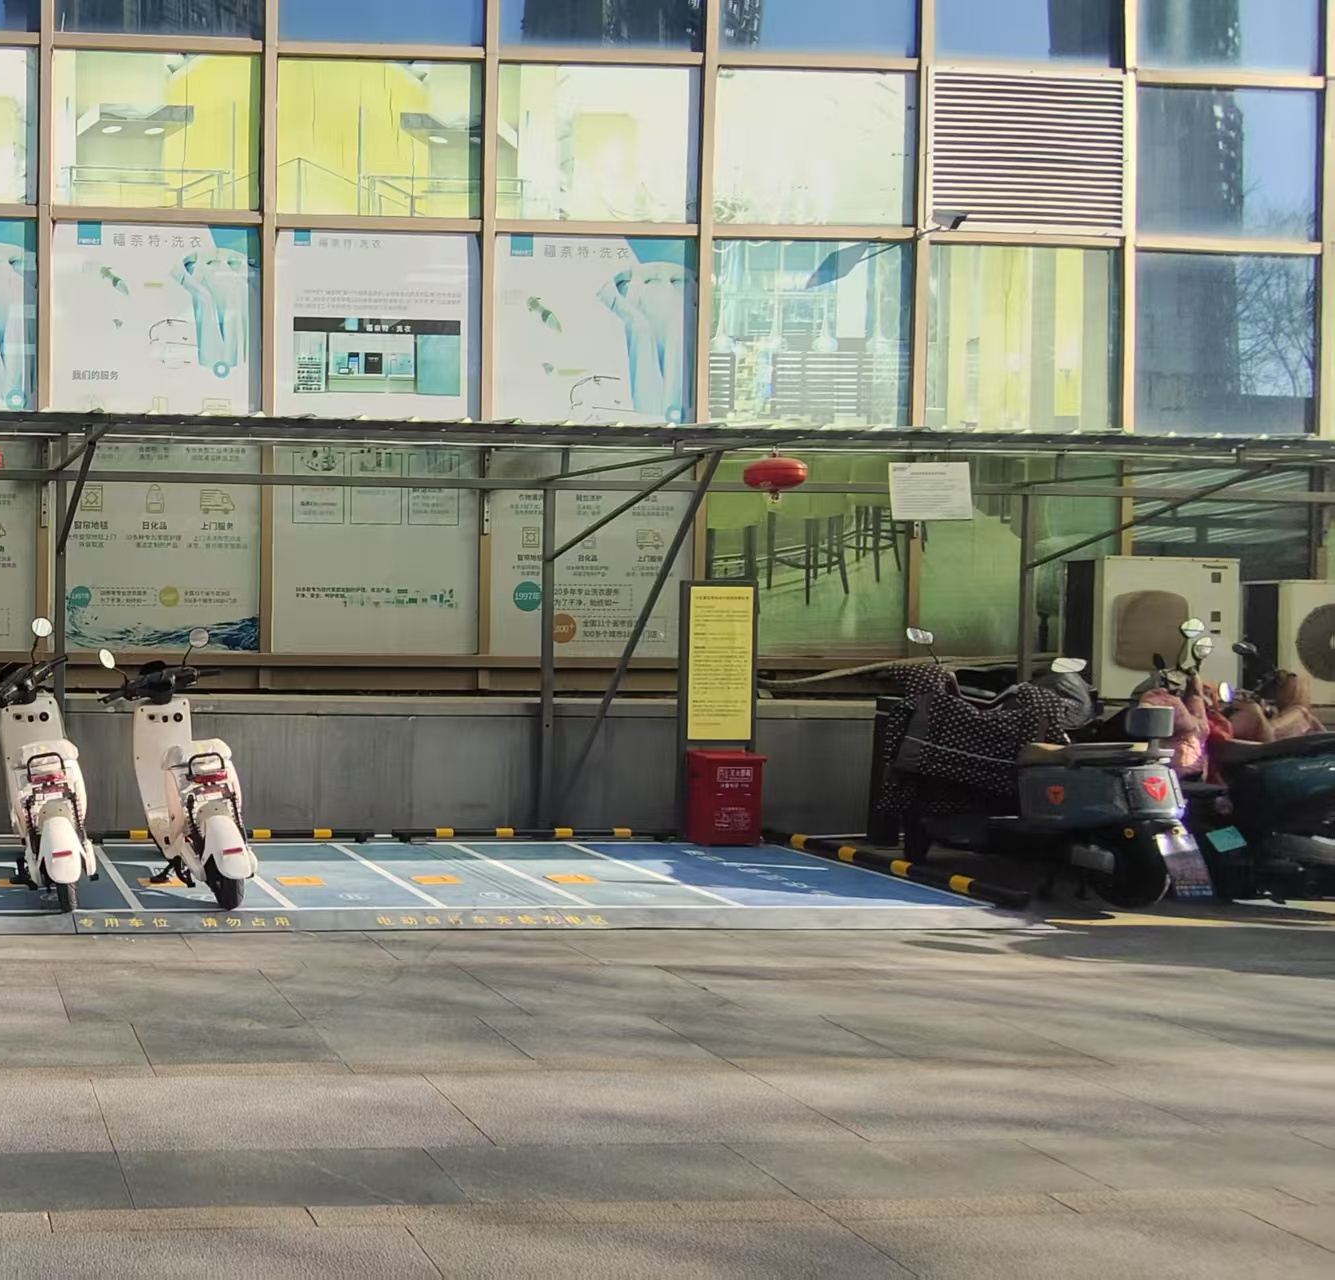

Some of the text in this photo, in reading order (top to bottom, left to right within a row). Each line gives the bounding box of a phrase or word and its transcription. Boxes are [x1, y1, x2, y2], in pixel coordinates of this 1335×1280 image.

[72, 370, 119, 381] 我们的服务
[73, 521, 108, 530] 窗帘地毯
[142, 521, 167, 530] 日化品
[200, 522, 233, 530] 上门服务
[78, 916, 291, 928] 专用车位 请勿占用
